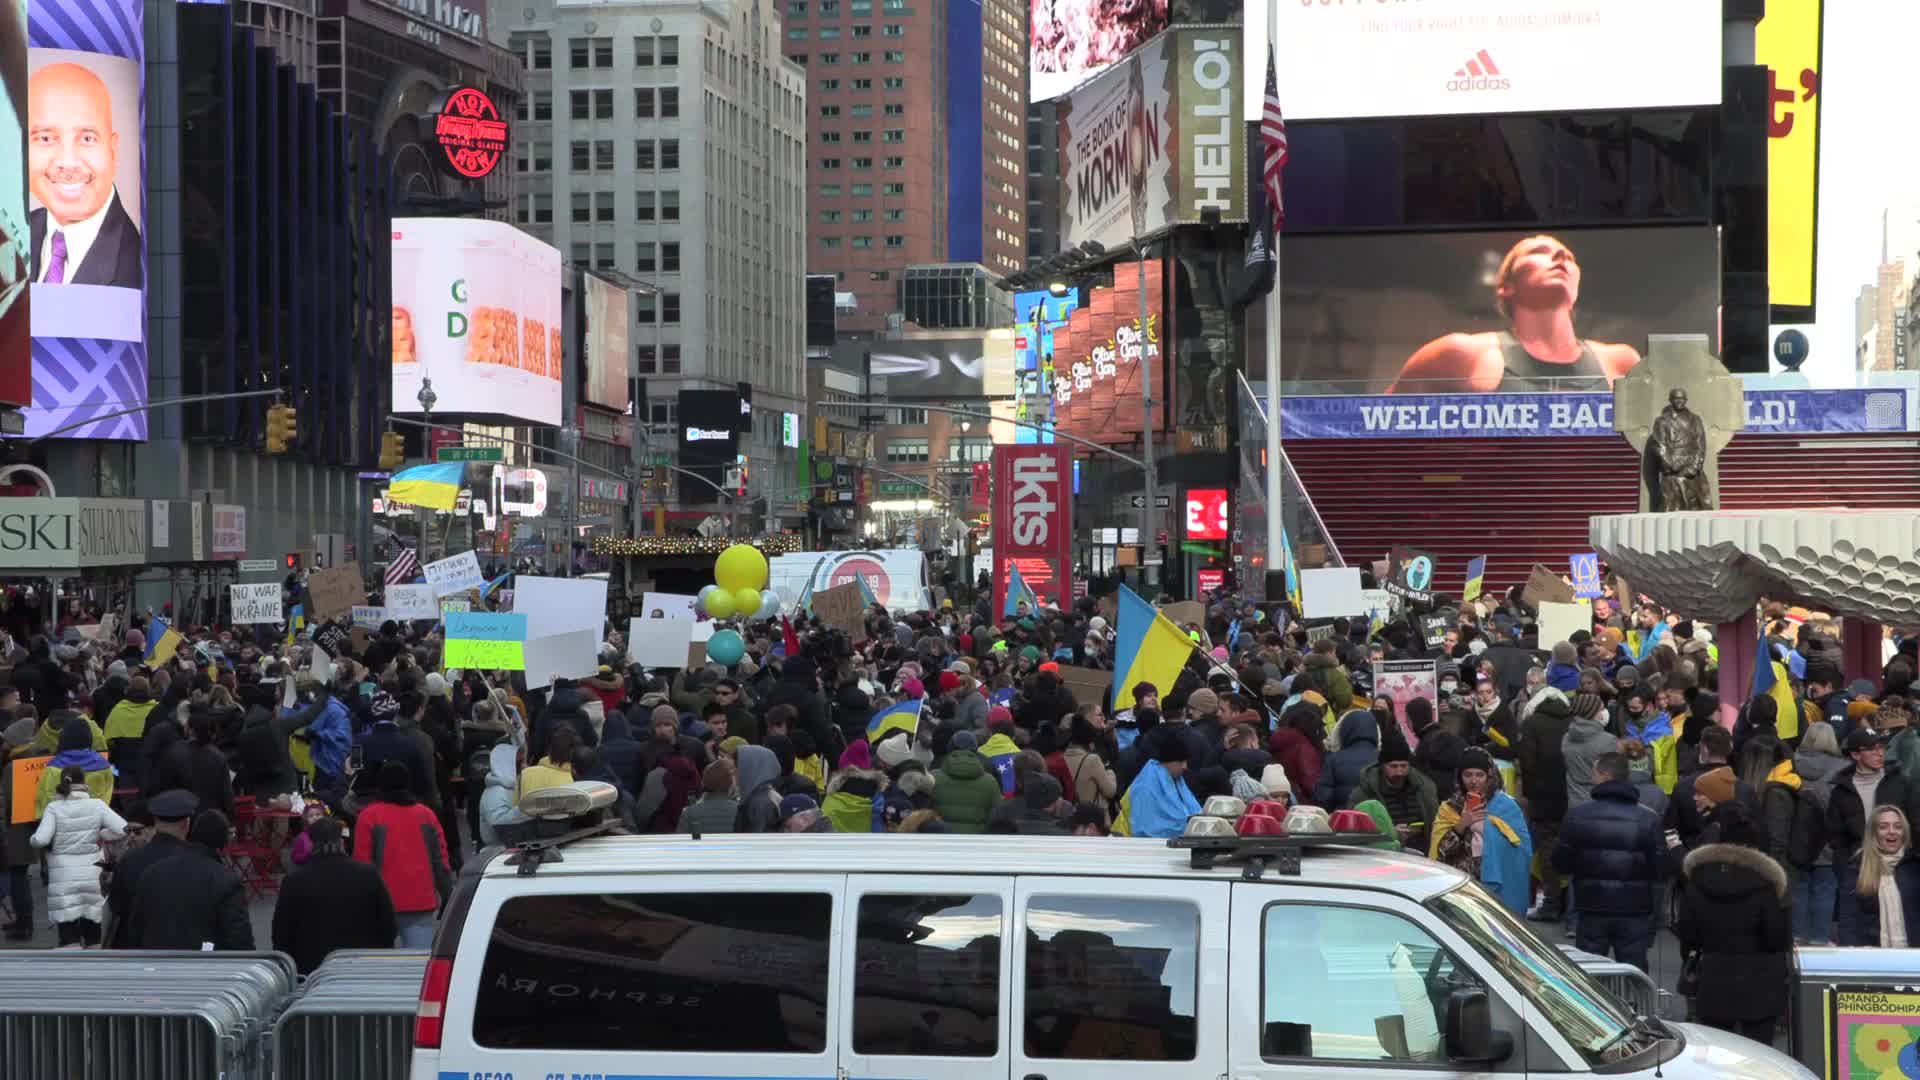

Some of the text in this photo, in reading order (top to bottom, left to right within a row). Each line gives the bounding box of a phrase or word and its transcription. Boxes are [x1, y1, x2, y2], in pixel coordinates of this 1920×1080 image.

[1446, 76, 1511, 92] adidas
[455, 94, 488, 114] HOT
[1076, 100, 1126, 163] THE BOOK OF
[1193, 39, 1231, 210] HELLO!
[455, 149, 490, 169] NOW
[1360, 404, 1539, 431] WELCOME
[1550, 403, 1613, 428] BAC
[1013, 453, 1058, 546] tkts
[232, 586, 248, 600] NO
[232, 602, 279, 620] UKRAINE
[1427, 617, 1446, 628] SAVE
[1839, 993, 1888, 1004] AMANDA
